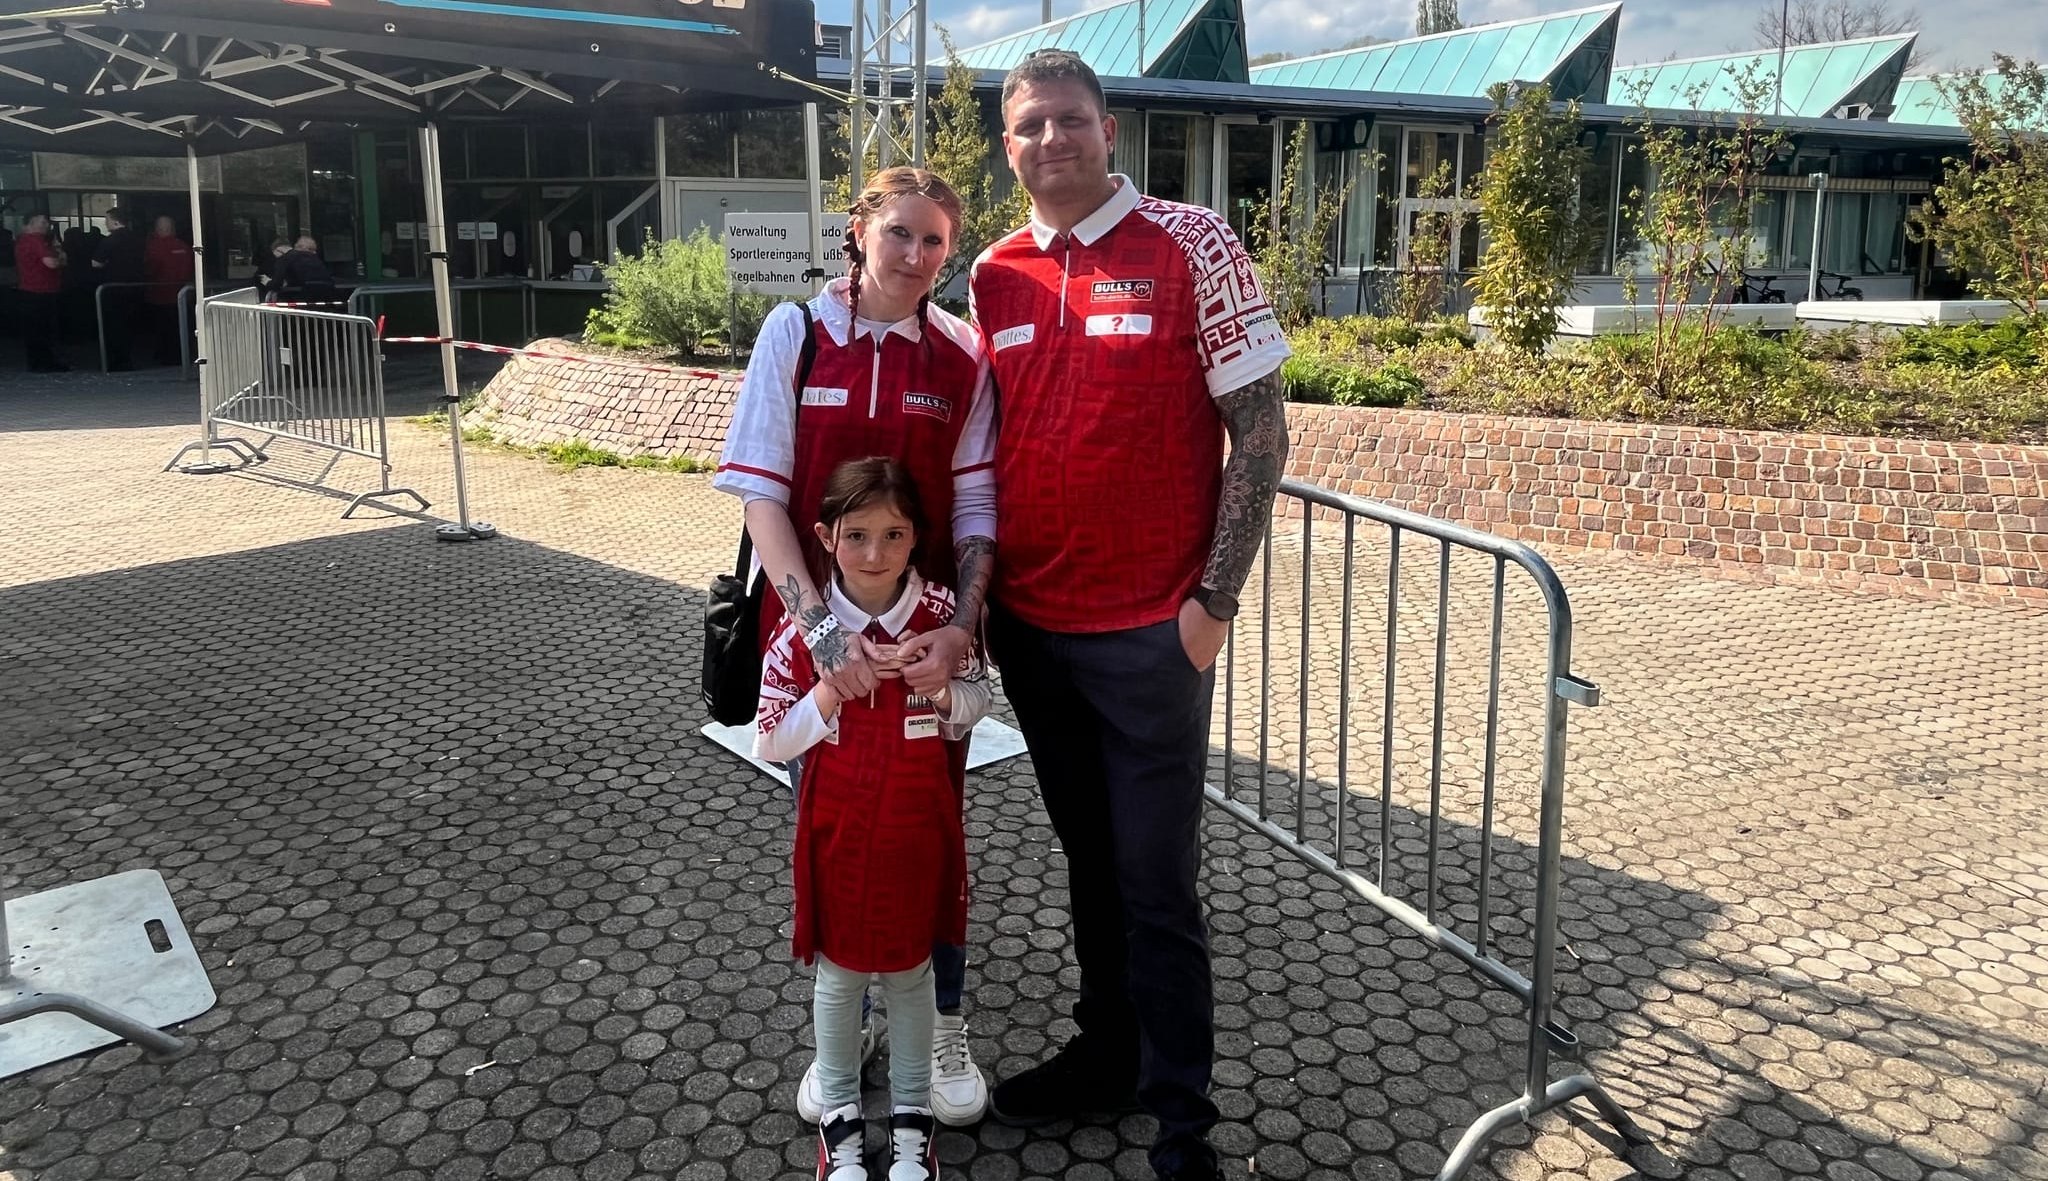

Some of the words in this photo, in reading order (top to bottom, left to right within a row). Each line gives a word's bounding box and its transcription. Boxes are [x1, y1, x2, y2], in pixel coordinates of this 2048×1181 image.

[730, 226, 786, 239] Verwaltung
[821, 226, 841, 237] udo
[730, 248, 811, 262] Sportlereingang
[1094, 282, 1132, 293] BULL'S
